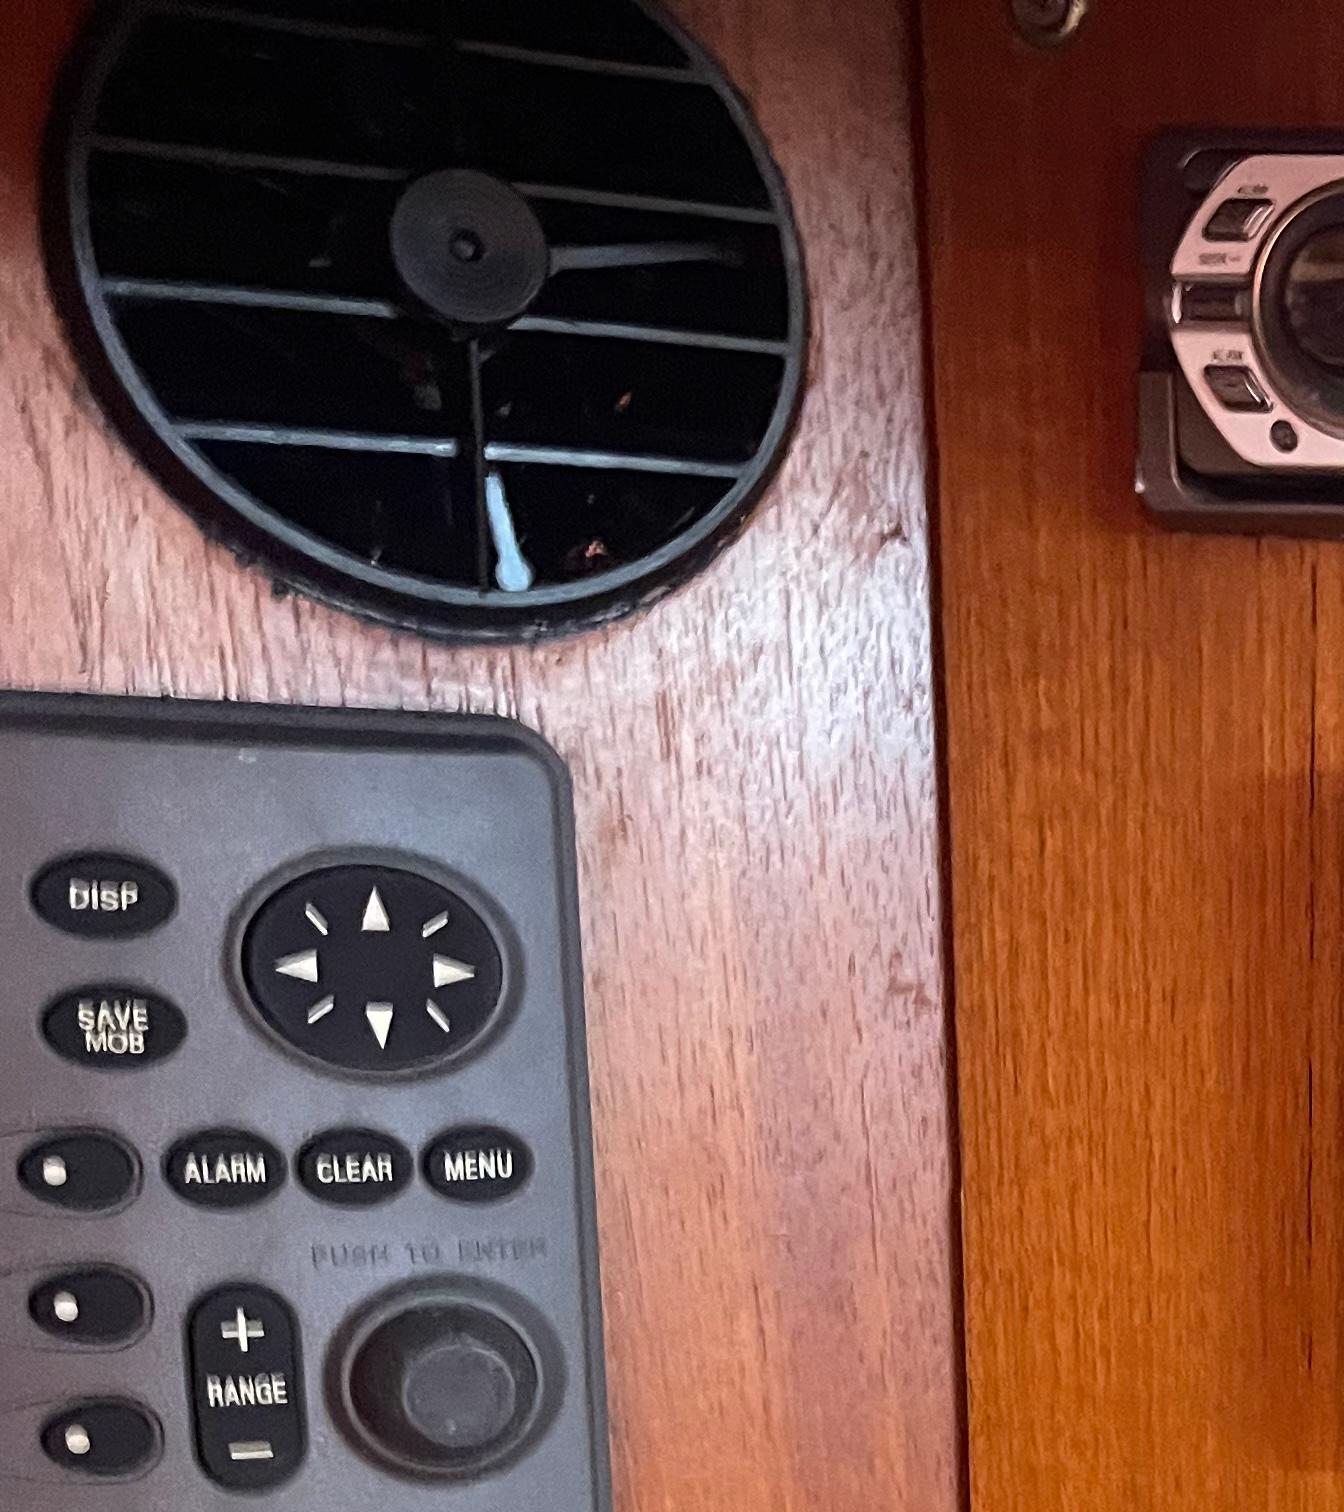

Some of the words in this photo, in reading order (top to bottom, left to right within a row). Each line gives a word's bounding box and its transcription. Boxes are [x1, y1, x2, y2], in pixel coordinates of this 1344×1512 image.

[69, 876, 140, 912] DISP
[78, 1000, 149, 1032] SAVE
[84, 1031, 145, 1055] MOB
[184, 1151, 267, 1185] ALARM
[317, 1151, 394, 1184] CLEAR
[443, 1147, 514, 1182] MENU
[311, 1241, 391, 1269] PUSH
[405, 1240, 442, 1266] TO
[206, 1373, 289, 1408] RANGE
